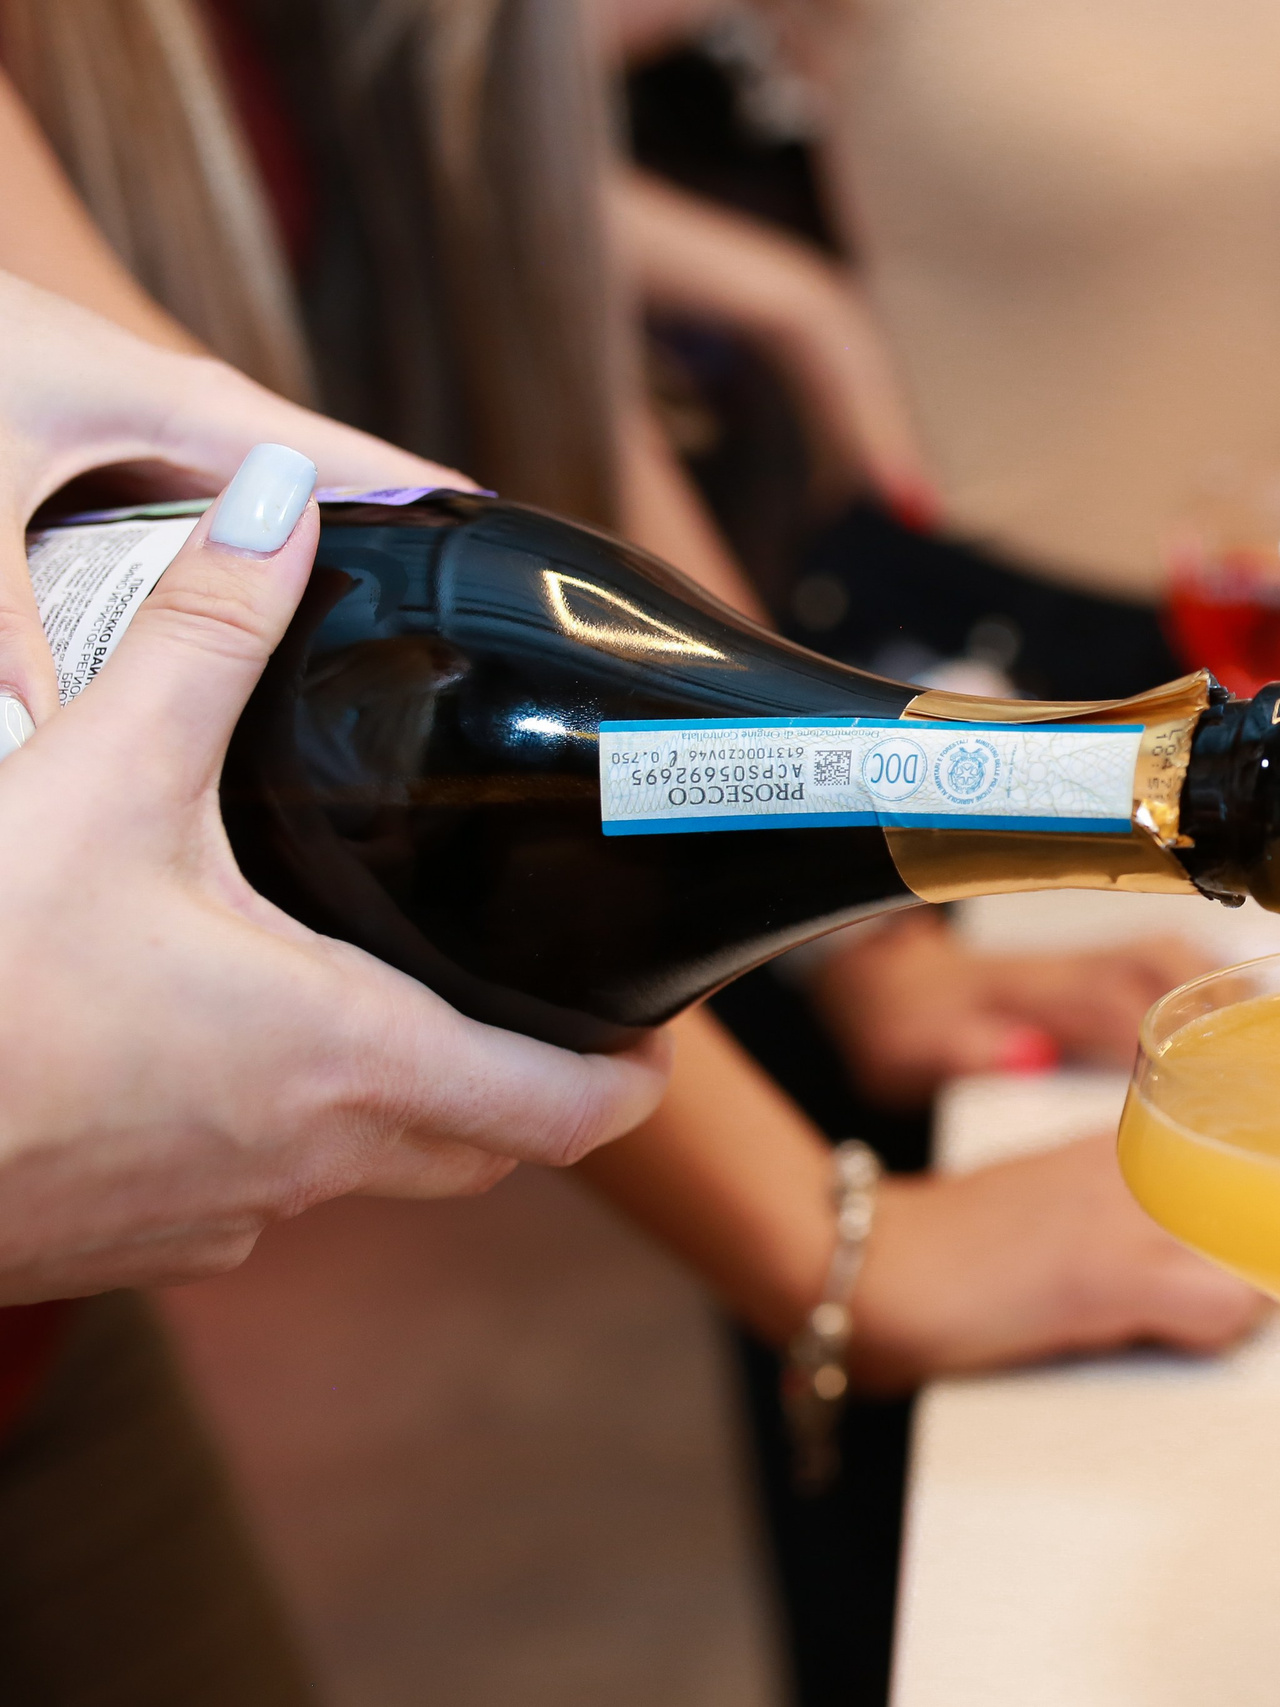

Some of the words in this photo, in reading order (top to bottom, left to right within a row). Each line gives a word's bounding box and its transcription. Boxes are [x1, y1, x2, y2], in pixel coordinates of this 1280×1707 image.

[99, 578, 144, 643] ПРОСЕККО
[83, 592, 119, 650] ИГРИСТОЕ
[681, 730, 738, 741] Controllata
[741, 729, 781, 739] Origine
[782, 730, 793, 739] di
[611, 752, 660, 765] 0.750
[940, 739, 968, 758] FORESTALI
[632, 764, 803, 786] ACPS05692695
[870, 752, 919, 784] DOC
[668, 783, 805, 806] PROSECCO
